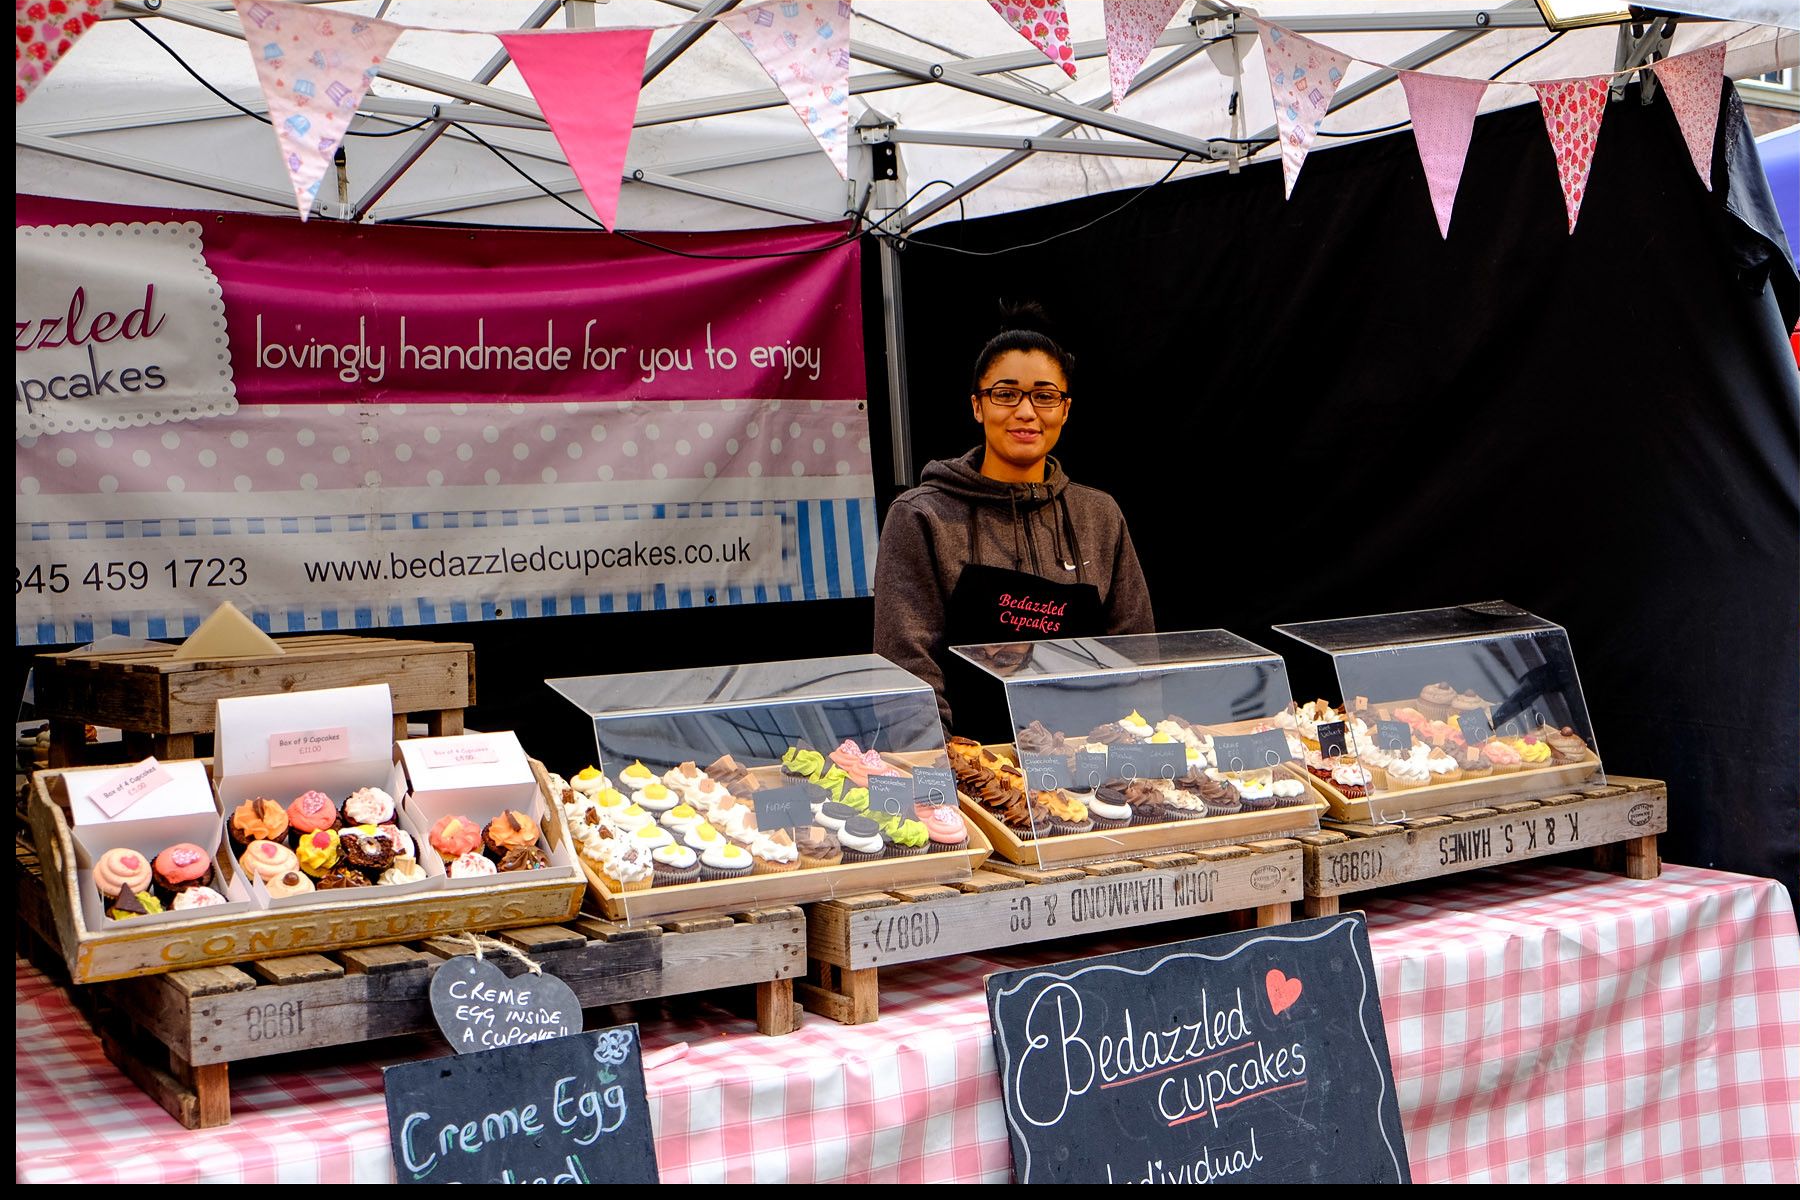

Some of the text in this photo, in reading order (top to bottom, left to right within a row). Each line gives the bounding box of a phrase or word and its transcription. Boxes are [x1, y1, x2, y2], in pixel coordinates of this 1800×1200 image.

[255, 313, 822, 384] lovingly handmade for you to enjoy
[16, 343, 167, 414] pcakes
[83, 536, 752, 592] 459 1723 www.bedazzledcupcakes.co.uk
[999, 593, 1067, 617] Bedazzled
[1000, 610, 1060, 634] Cupcakes
[279, 739, 292, 747] Box
[309, 734, 340, 745] Cupcakes
[103, 790, 117, 799] Box
[116, 784, 124, 792] of
[129, 766, 156, 784] Cupcakes
[1521, 819, 1537, 851] K.
[1545, 818, 1556, 846] &
[1563, 811, 1580, 842] K.
[1440, 827, 1492, 867] HAINES
[1071, 876, 1163, 922] HAMMOND
[1173, 869, 1219, 907] JOHN
[1044, 894, 1057, 927] &
[160, 900, 527, 963] CONFITURES
[449, 980, 532, 1006] CREME
[455, 1005, 563, 1028] EGG INSIDE
[463, 1028, 474, 1044] A
[1016, 982, 1252, 1126] Bedazzled
[553, 1076, 628, 1147] Egg
[400, 1103, 545, 1181] Creme
